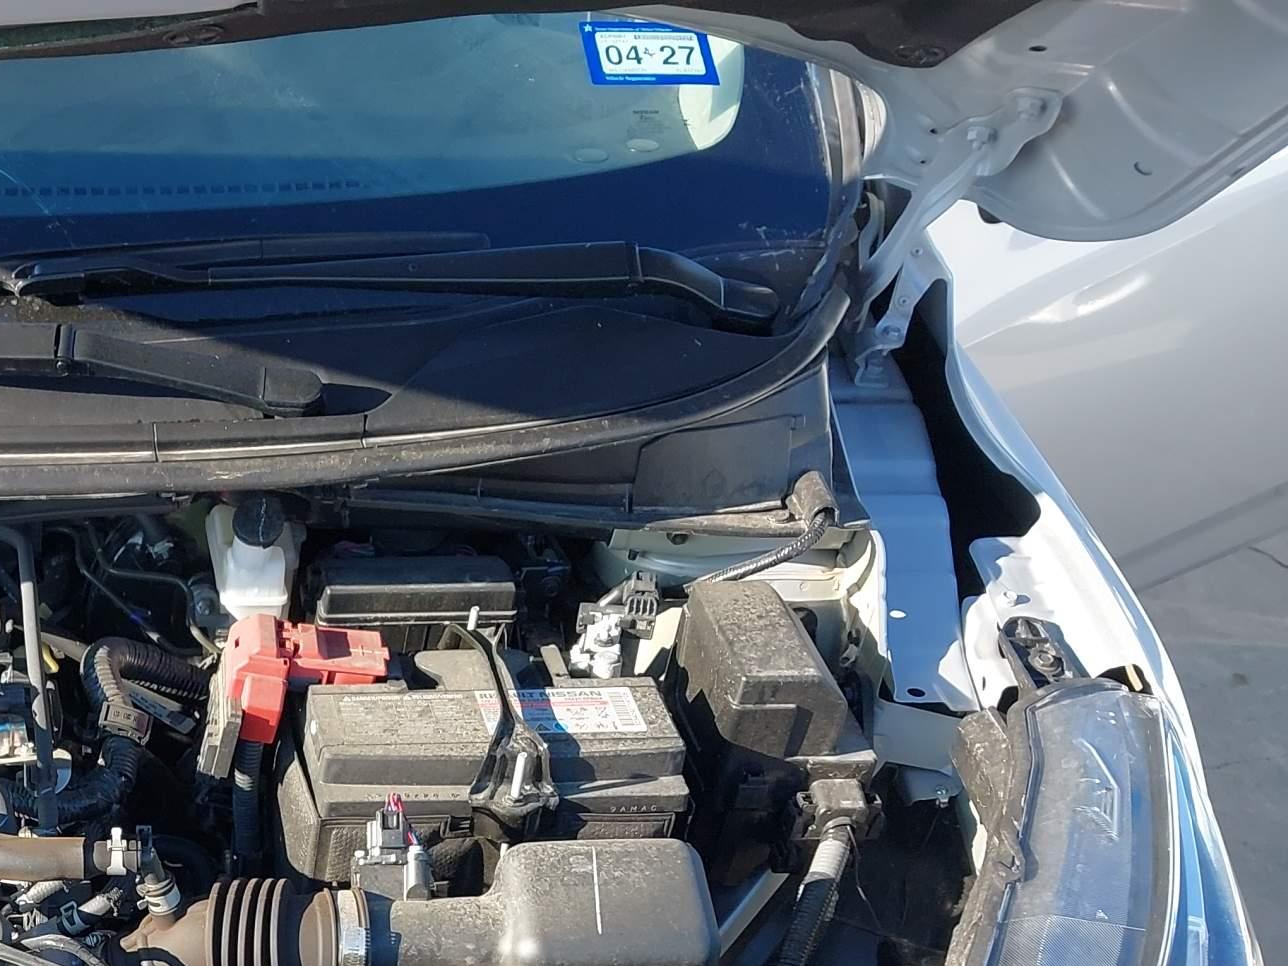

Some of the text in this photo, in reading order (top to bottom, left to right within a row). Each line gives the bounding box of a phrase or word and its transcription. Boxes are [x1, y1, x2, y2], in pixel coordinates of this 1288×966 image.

[605, 45, 695, 66] 04 27
[540, 690, 602, 698] NISSAN
